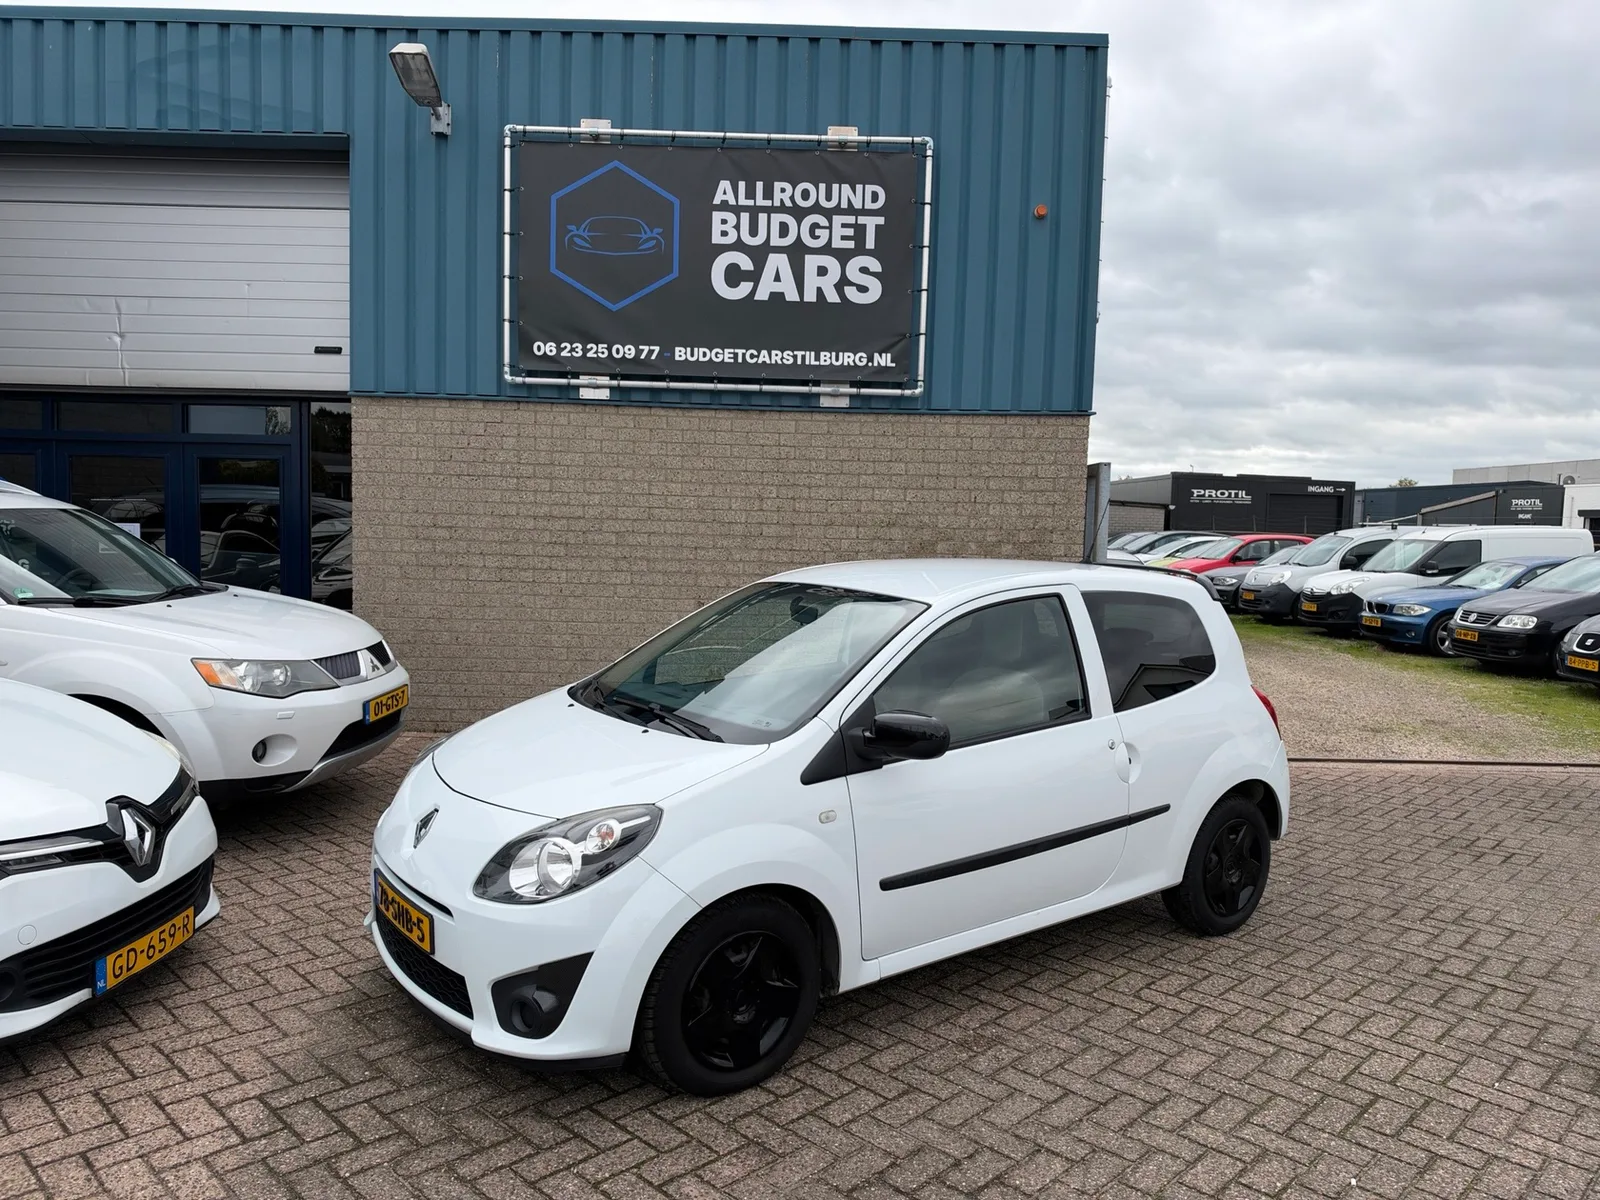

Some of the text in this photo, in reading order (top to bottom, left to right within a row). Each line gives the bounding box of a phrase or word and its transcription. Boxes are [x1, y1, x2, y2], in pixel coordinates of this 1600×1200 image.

[712, 179, 887, 210] ALLROUND
[711, 210, 886, 250] BUDGET
[710, 250, 884, 306] CARS
[532, 340, 558, 356] 06
[559, 341, 584, 358] 23
[585, 342, 610, 359] 25
[611, 343, 637, 360] 09
[637, 344, 661, 361] 77
[673, 346, 897, 368] BUDGETCARSTILBURG.NL
[1190, 488, 1252, 499] PROTIL
[1307, 485, 1334, 493] INGANG
[1510, 498, 1543, 506] PROTIL
[1567, 654, 1598, 671] 84-PPB-5
[373, 688, 406, 718] 01-GTS-7
[377, 879, 426, 944] 78-SHB-5
[112, 913, 191, 980] GD-659-R
[97, 979, 106, 989] NL
